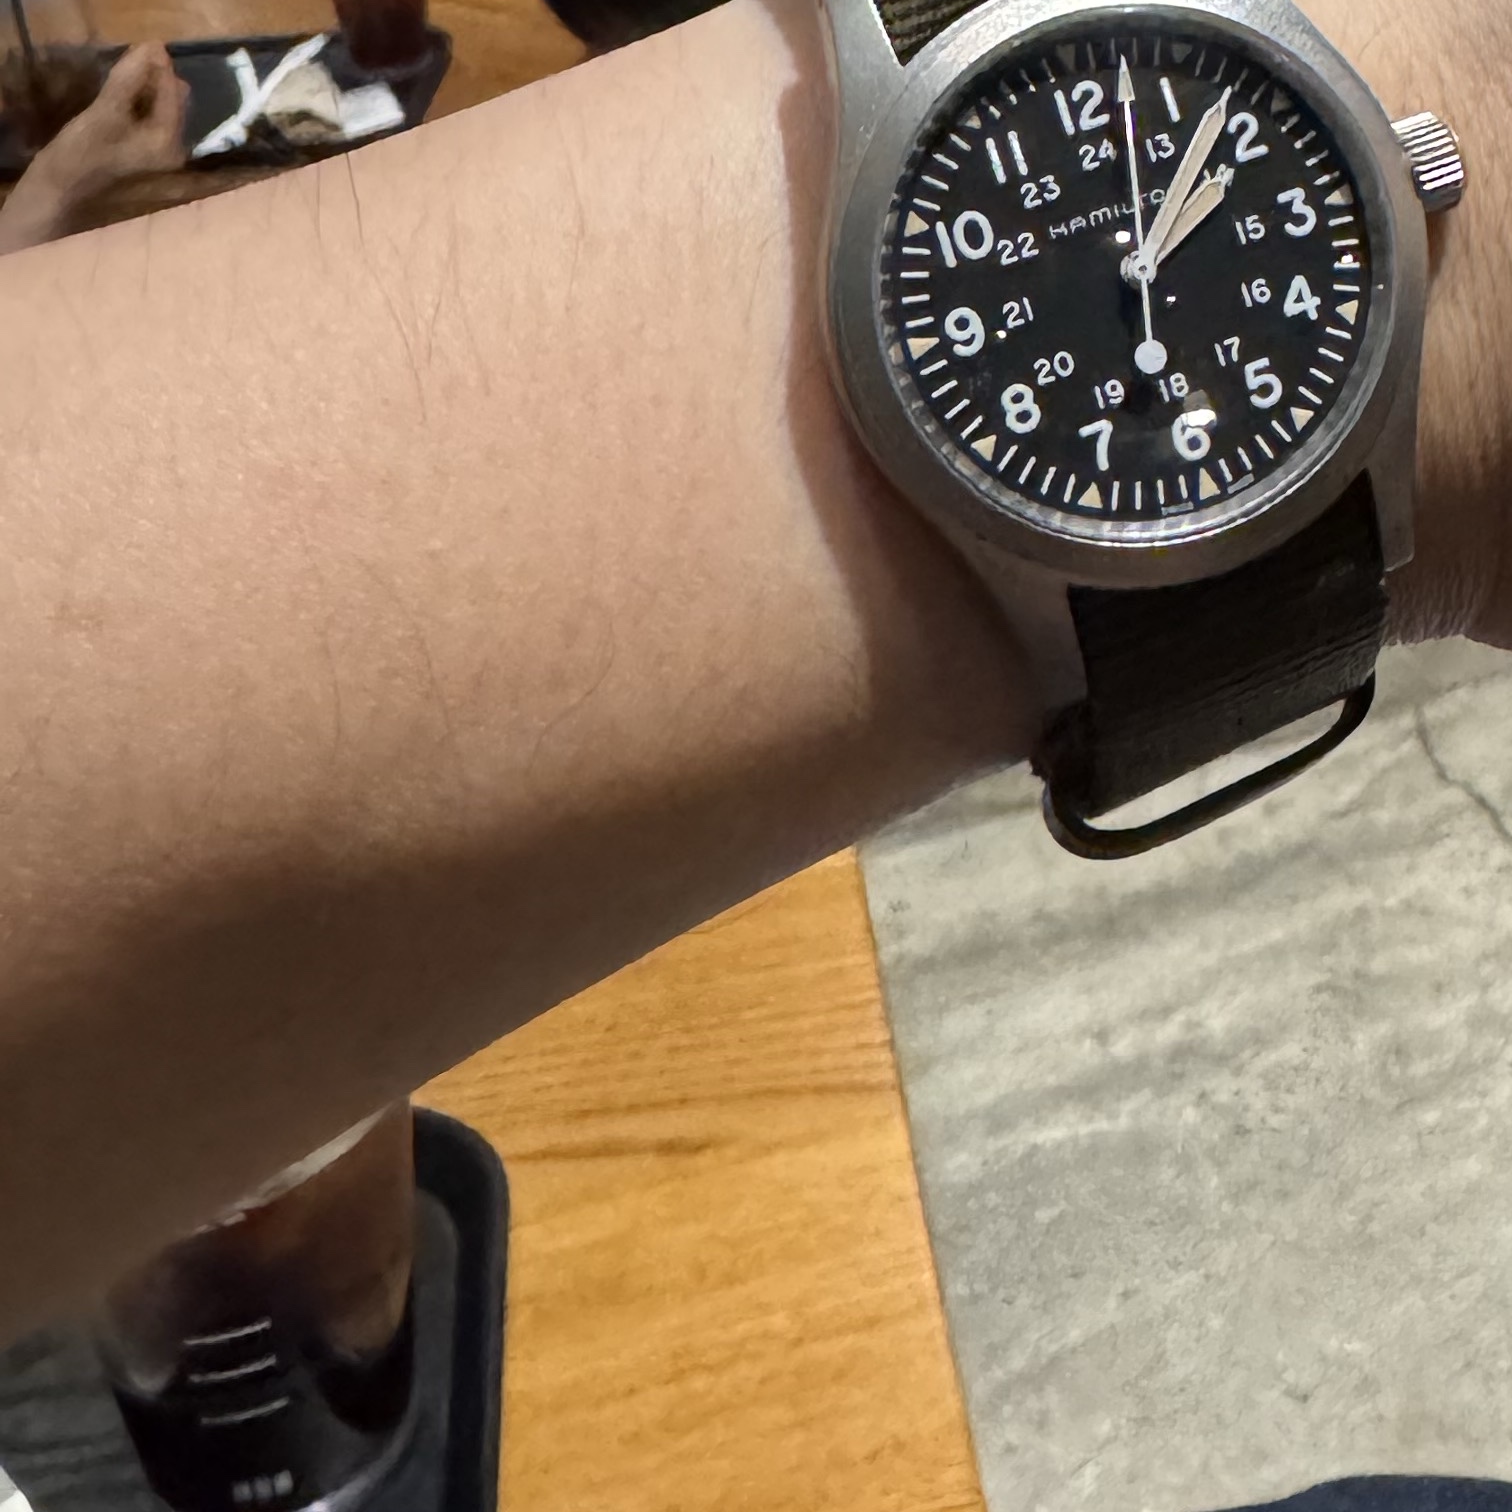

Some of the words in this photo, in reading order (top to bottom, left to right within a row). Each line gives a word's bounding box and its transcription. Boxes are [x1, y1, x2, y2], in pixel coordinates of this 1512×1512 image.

[1054, 80, 1110, 135] 12
[1160, 77, 1180, 122] 1
[986, 131, 1029, 183] 11
[1079, 139, 1116, 170] 24
[1146, 133, 1175, 162] 13
[1226, 112, 1268, 162] 2
[1019, 174, 1060, 208] 23
[1277, 187, 1316, 236] 3
[1048, 188, 1168, 240] HAMILTO
[1235, 215, 1265, 244] 15
[934, 209, 994, 268] 10
[997, 233, 1039, 265] 22
[1003, 297, 1033, 328] 21
[1241, 278, 1271, 307] 16
[1284, 275, 1321, 320] 4
[945, 307, 985, 356] 9
[1215, 336, 1240, 366] 17
[1034, 351, 1074, 385] 20
[1158, 373, 1189, 403] 18
[1245, 357, 1282, 408] 5
[1001, 384, 1041, 433] 8
[1095, 379, 1124, 409] 19
[1079, 419, 1113, 471] 7
[1171, 409, 1217, 461] 6
